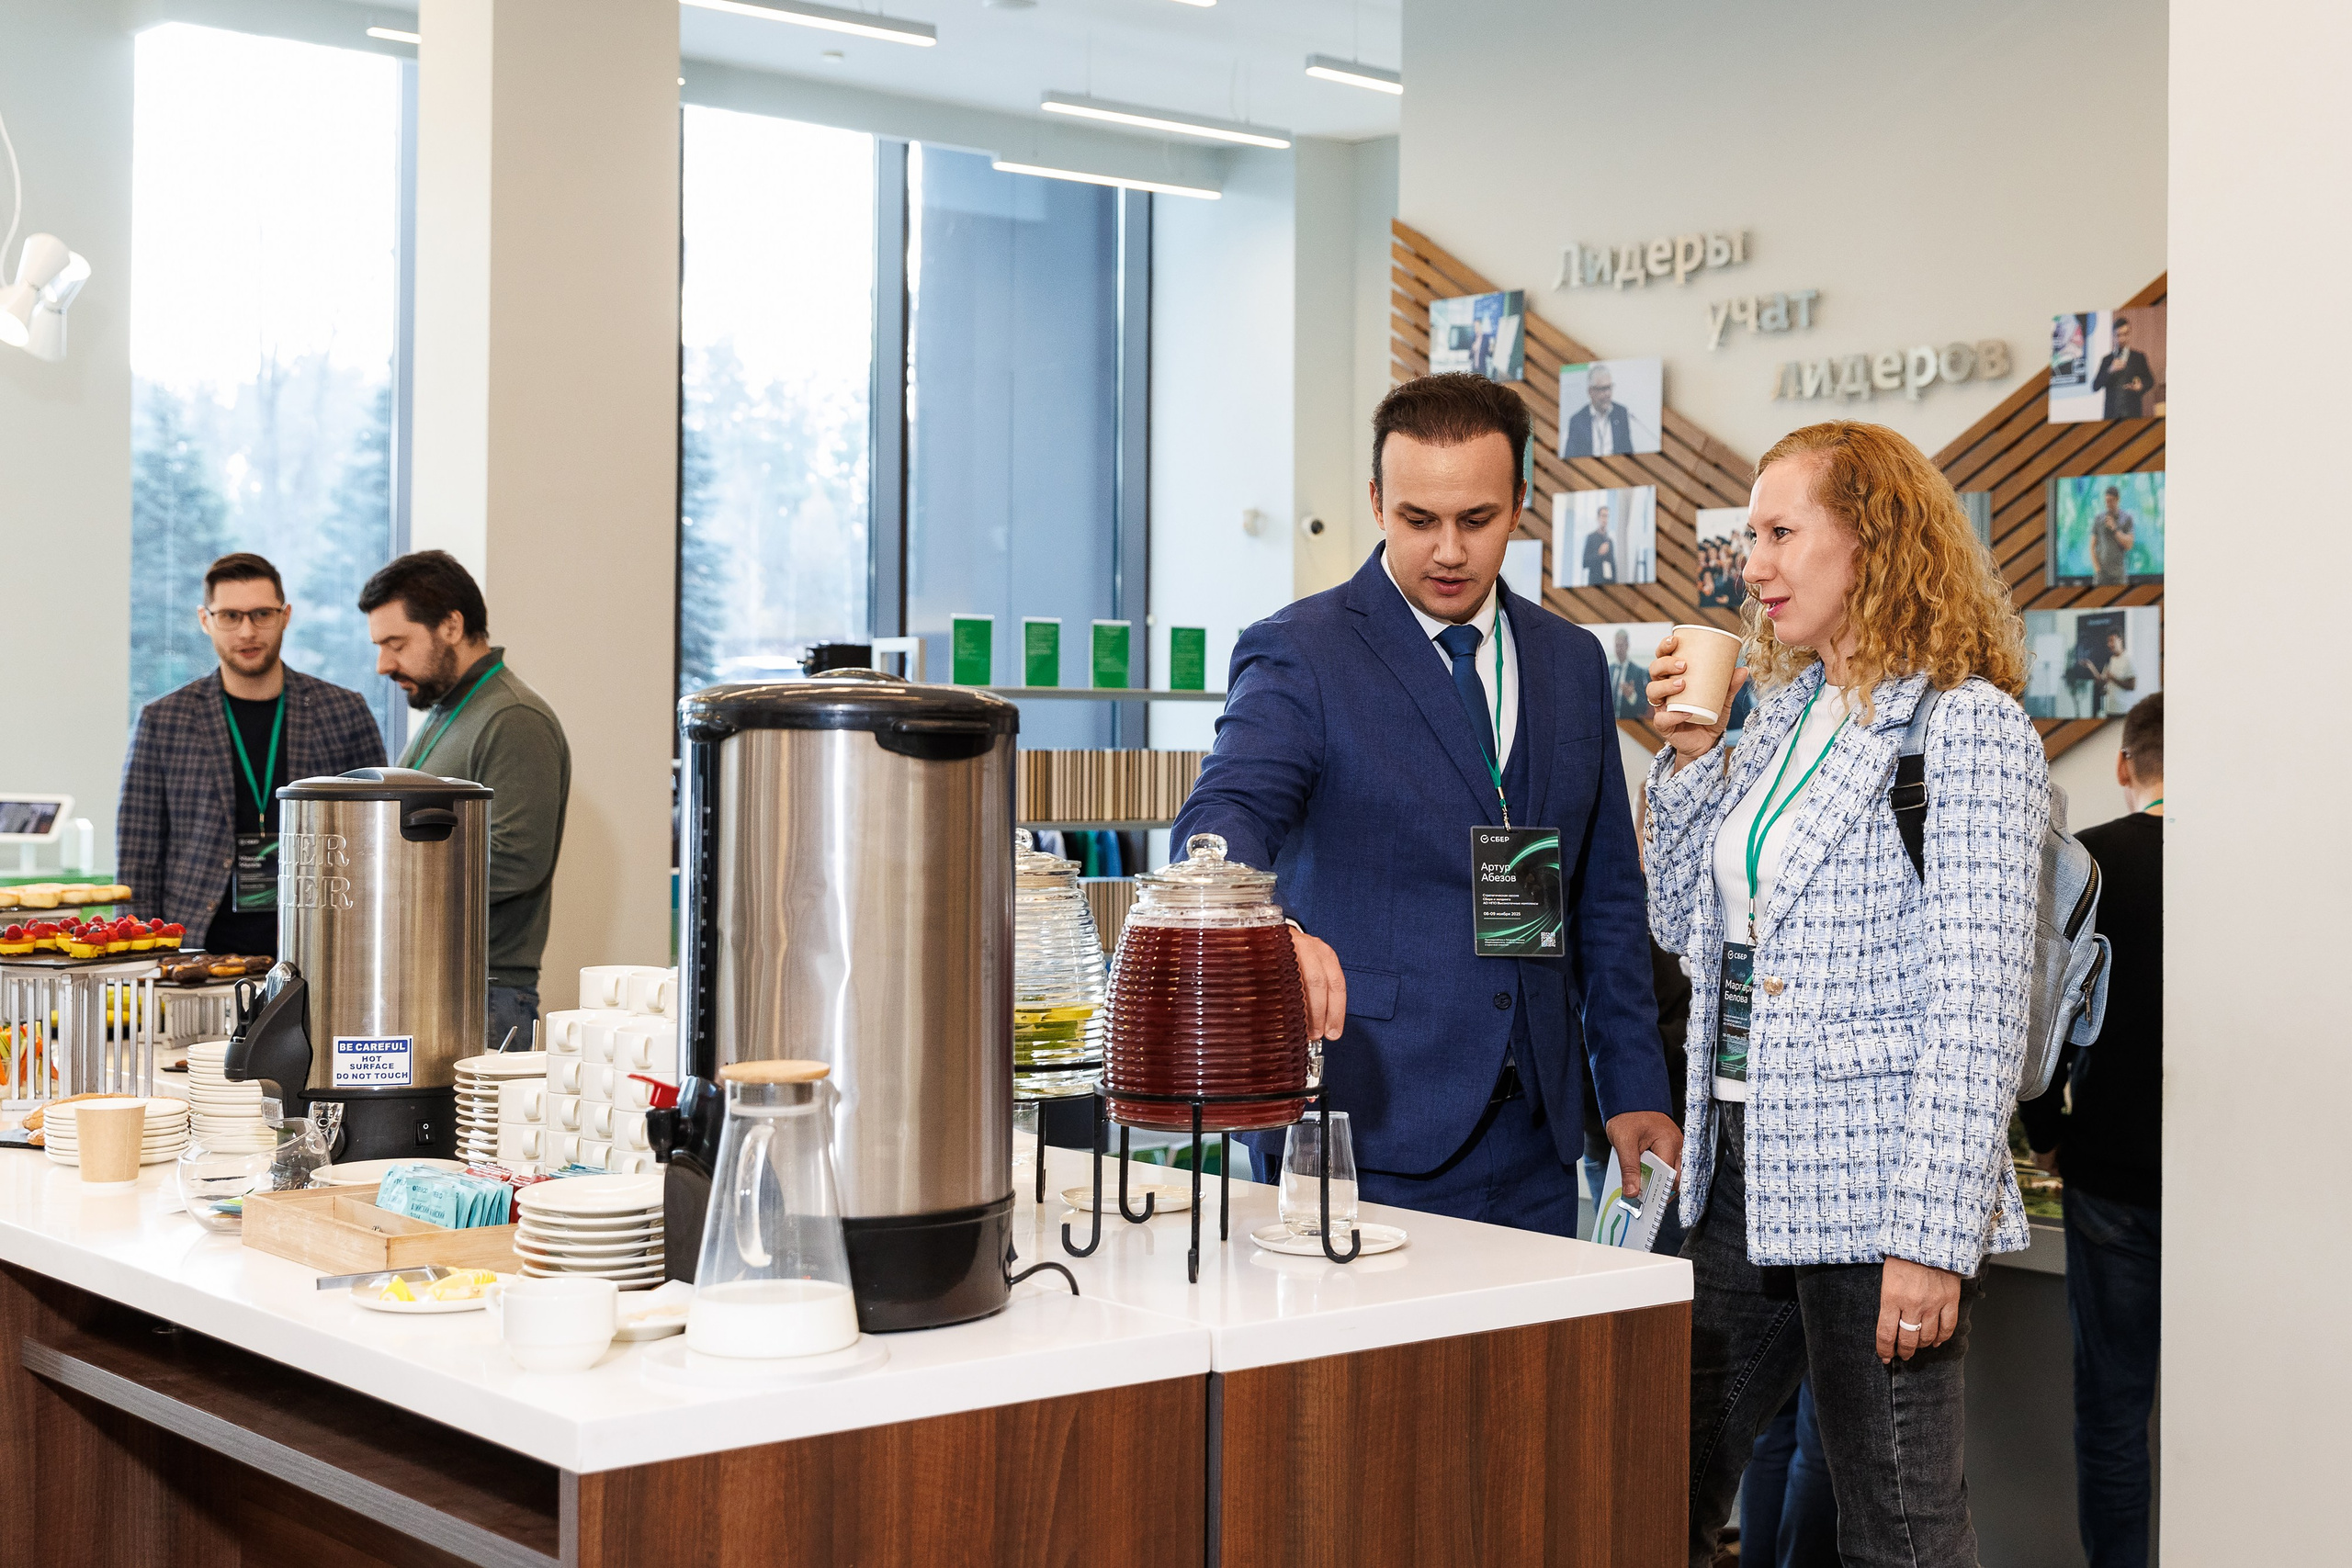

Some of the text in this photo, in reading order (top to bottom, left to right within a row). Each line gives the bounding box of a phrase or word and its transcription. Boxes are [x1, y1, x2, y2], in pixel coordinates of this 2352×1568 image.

[1553, 229, 1749, 292] Лидеры
[1706, 289, 1819, 350] учат
[1770, 338, 2012, 402] лидеров
[1480, 862, 1511, 874] Артур
[1480, 872, 1517, 883] Абезов
[1724, 990, 1748, 1004] Белова
[339, 1042, 406, 1051] BE CAREFUL
